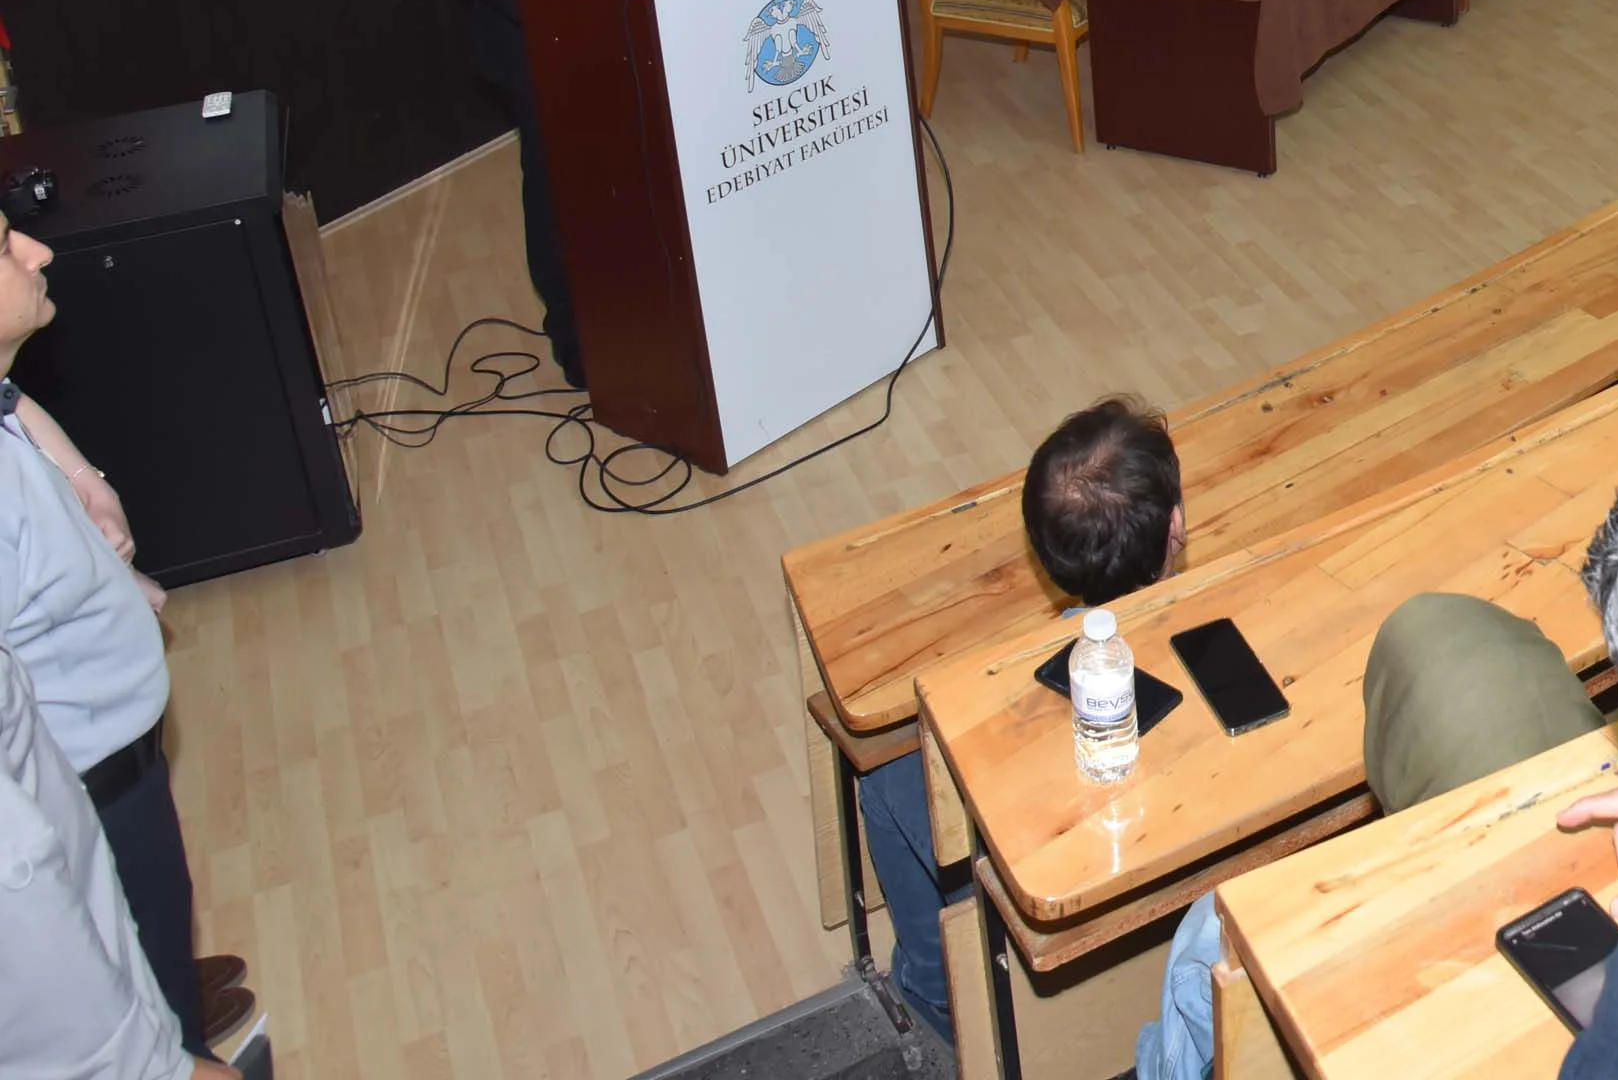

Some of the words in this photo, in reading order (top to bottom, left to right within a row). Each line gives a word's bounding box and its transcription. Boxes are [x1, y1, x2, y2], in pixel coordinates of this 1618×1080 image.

[720, 85, 870, 169] ÜNİVERSİTESİ
[752, 75, 836, 127] SELÇUK
[706, 150, 796, 205] EDEBİYAT
[799, 107, 889, 162] FAKÜLTESİ
